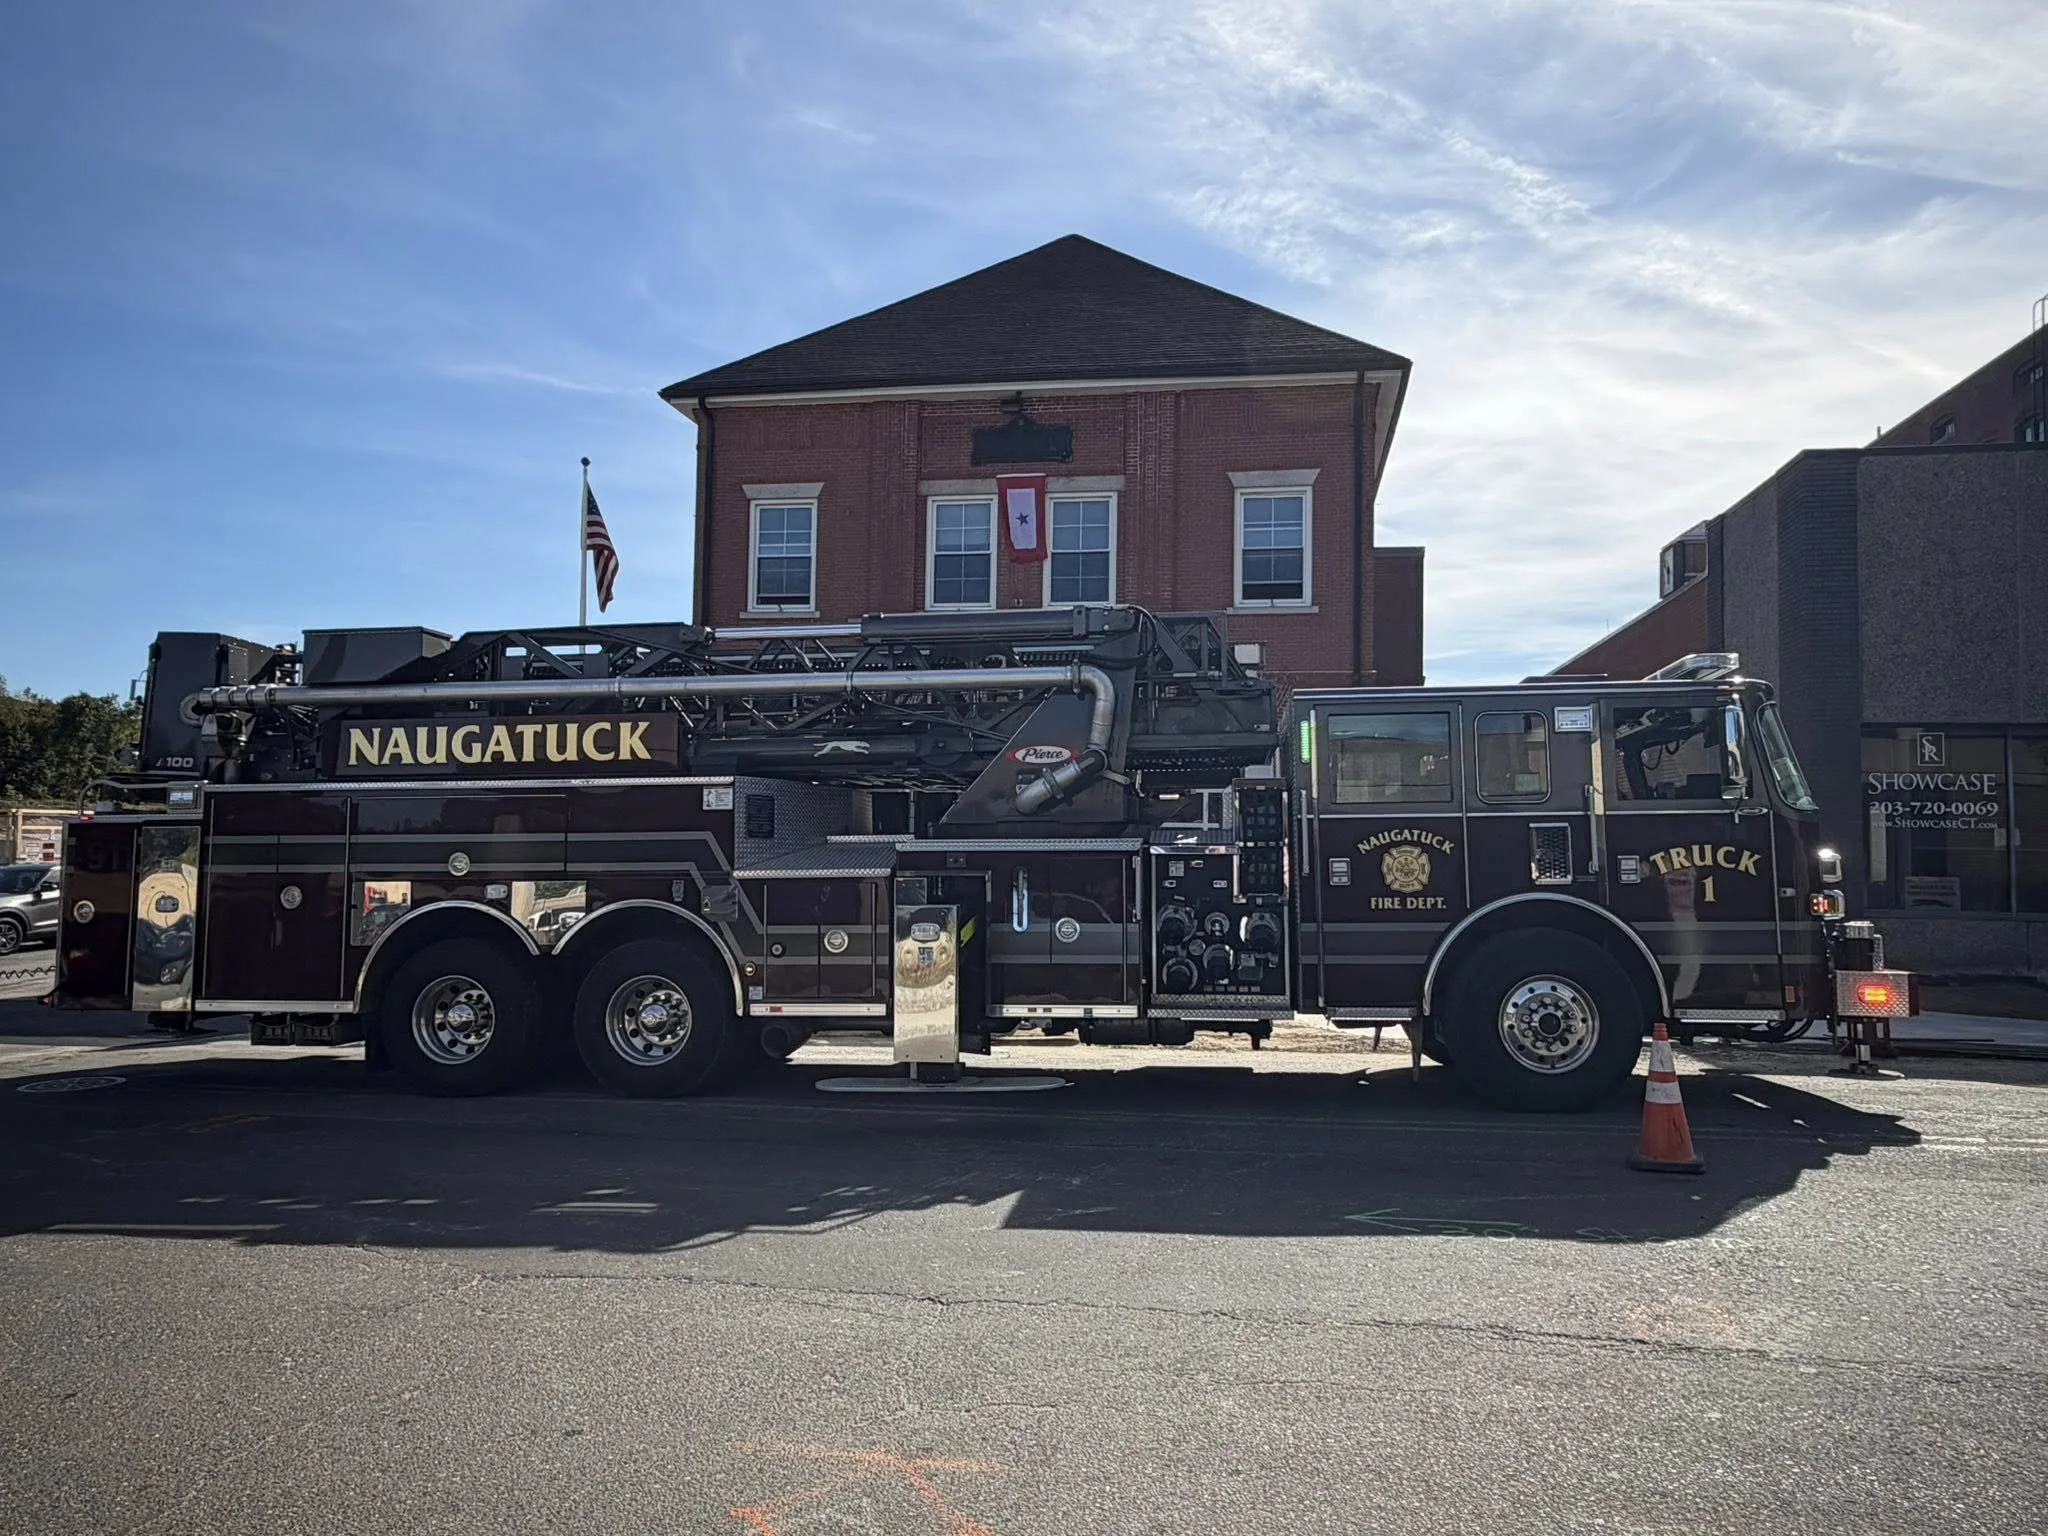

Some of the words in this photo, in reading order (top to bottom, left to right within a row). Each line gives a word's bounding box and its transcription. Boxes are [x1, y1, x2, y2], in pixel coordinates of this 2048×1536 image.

[347, 721, 652, 766] NAUGATUCK
[1022, 747, 1063, 762] Pierce
[1868, 772, 1998, 795] SHOWCASE
[1870, 801, 1999, 817] 203-720-0069
[1357, 829, 1455, 855] NAUGATUCK
[1649, 844, 1762, 876] TRUCK
[1702, 875, 1717, 902] 1
[1370, 897, 1401, 909] FIRE
[1406, 897, 1447, 909] DEPT.
